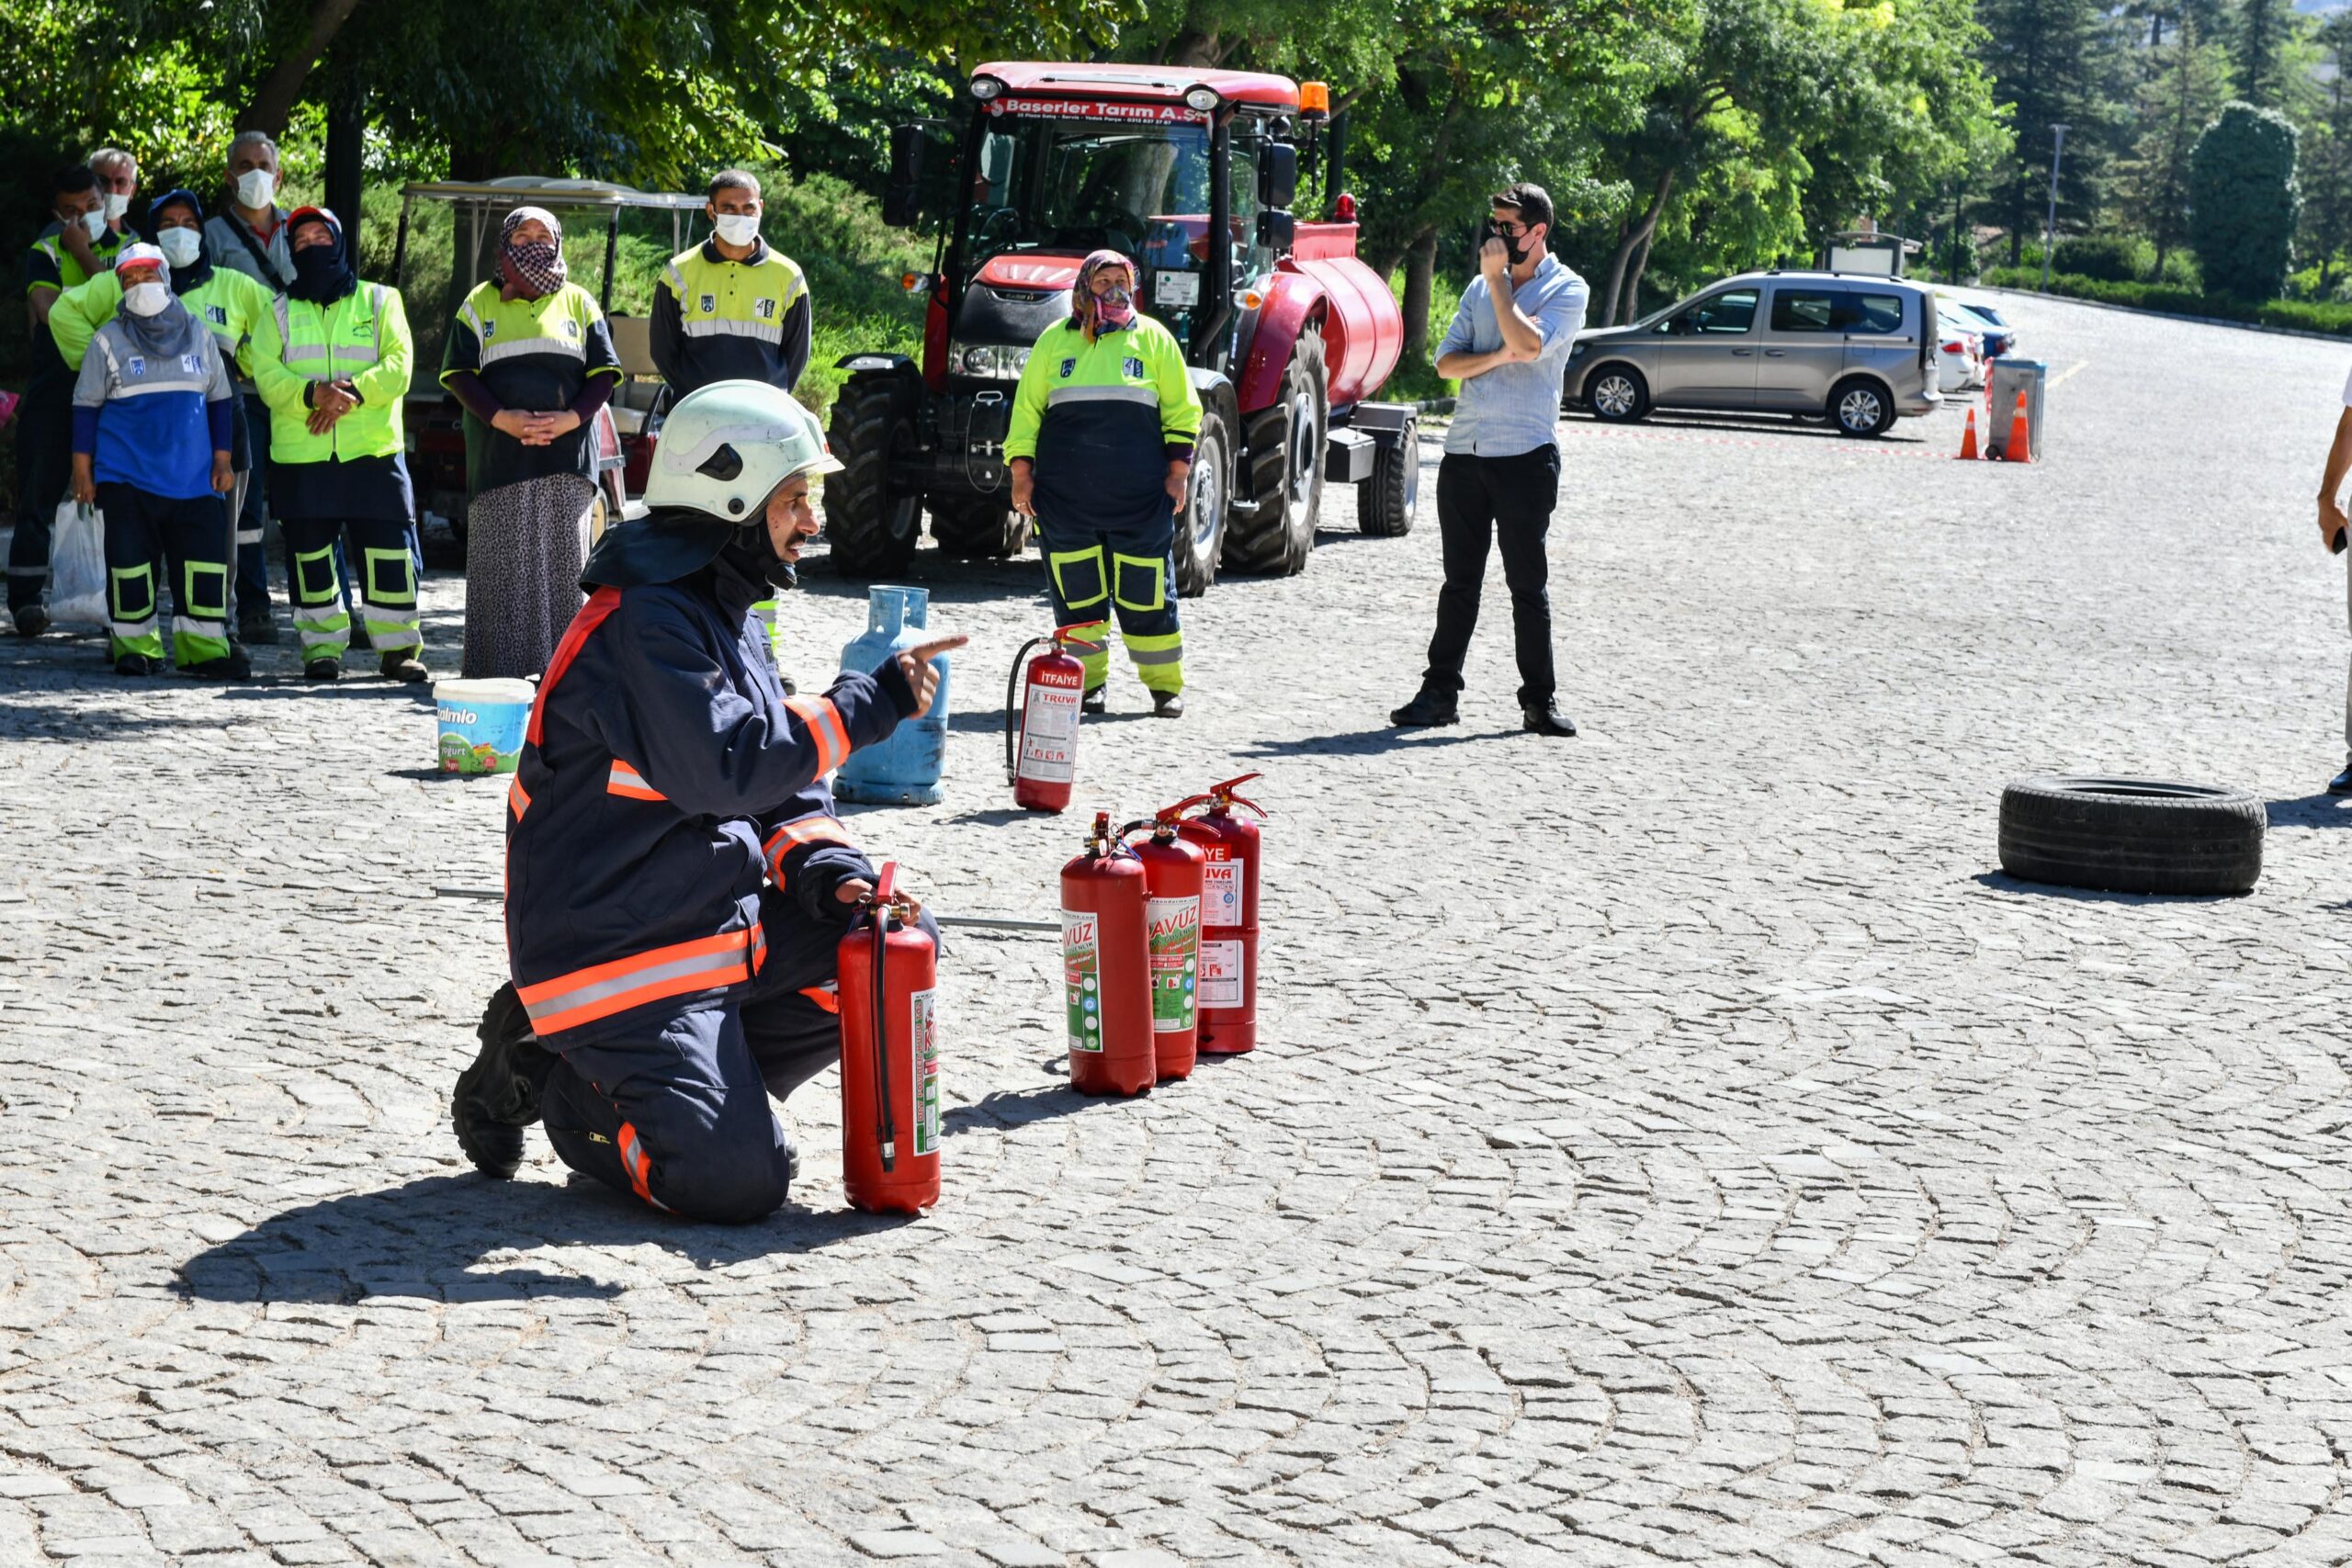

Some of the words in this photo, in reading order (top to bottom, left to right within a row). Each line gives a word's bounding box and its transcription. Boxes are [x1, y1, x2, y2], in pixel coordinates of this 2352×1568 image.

[1006, 99, 1091, 114] Başerler
[1095, 102, 1154, 118] Tarım
[1041, 671, 1078, 686] İTFAİYE
[1043, 694, 1078, 705] TRUVA
[1148, 905, 1196, 938] AVUZ
[1063, 922, 1092, 947] VUZ
